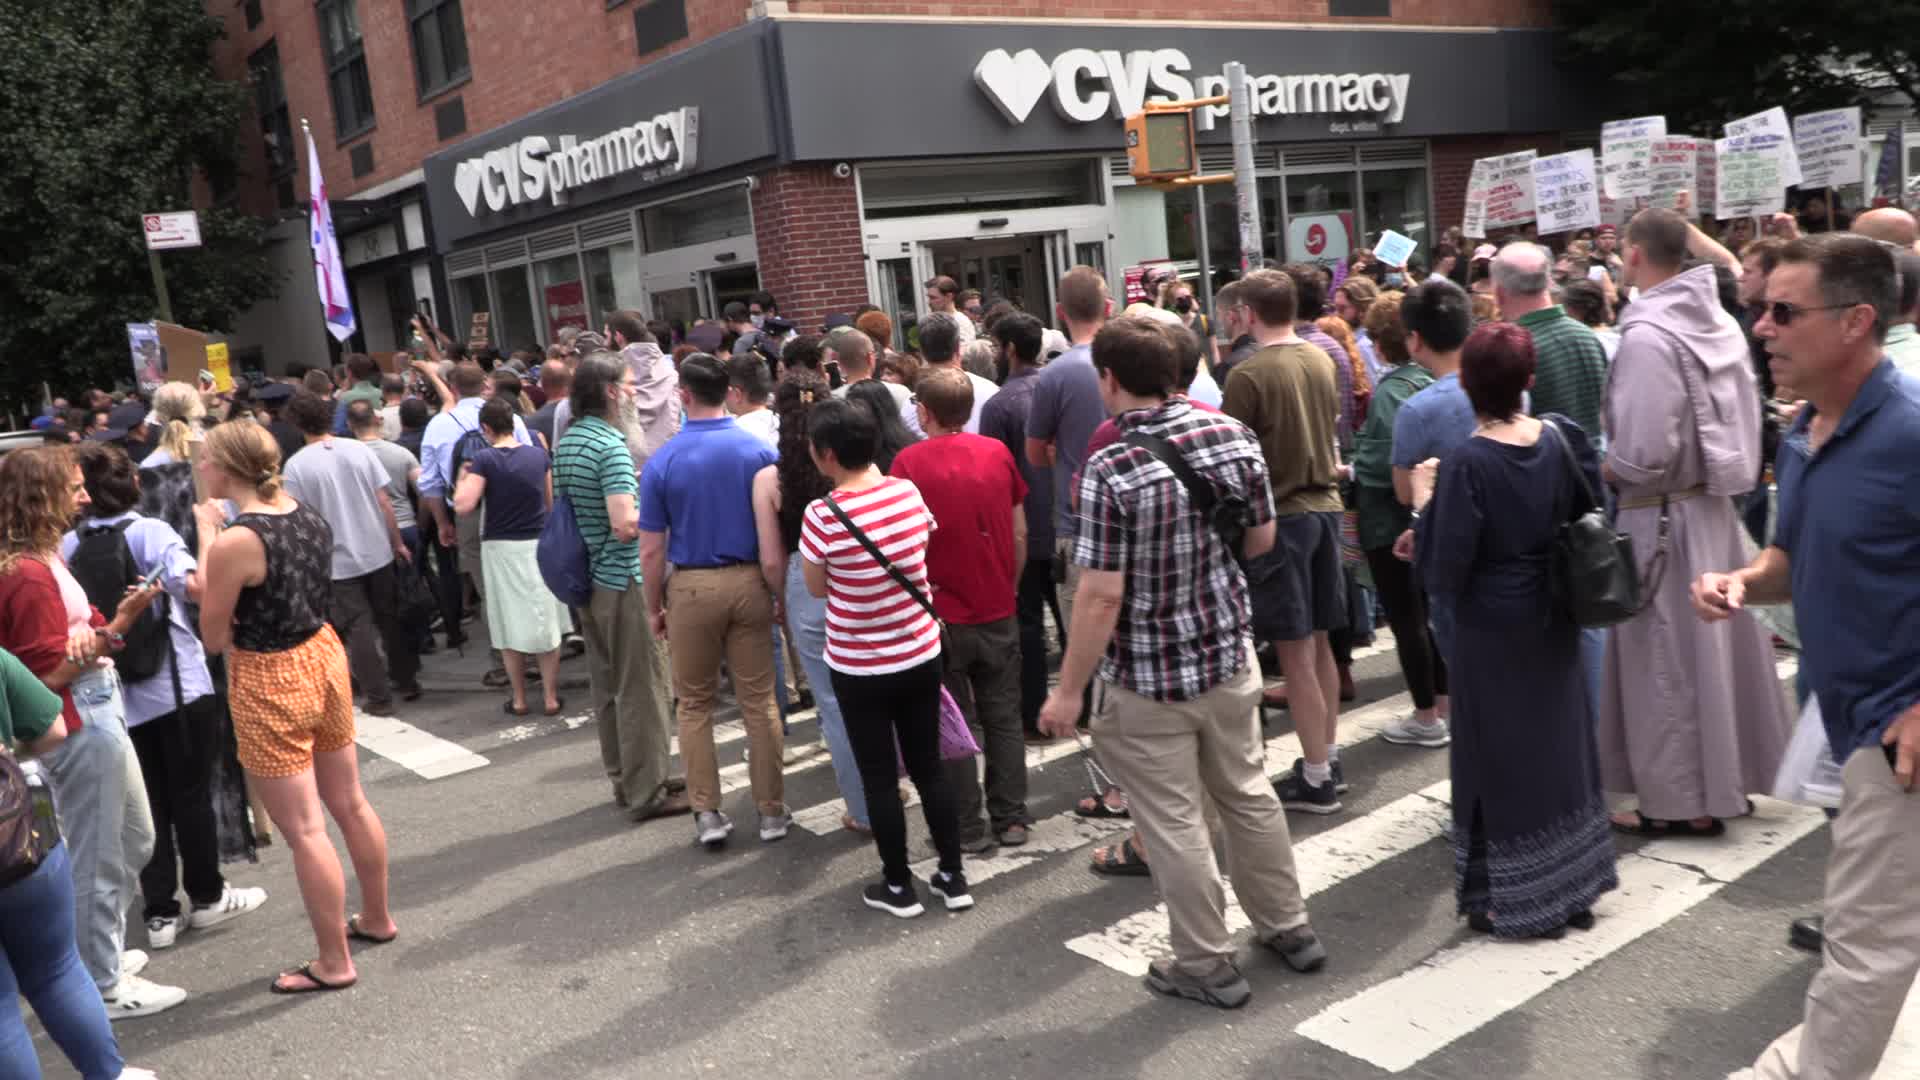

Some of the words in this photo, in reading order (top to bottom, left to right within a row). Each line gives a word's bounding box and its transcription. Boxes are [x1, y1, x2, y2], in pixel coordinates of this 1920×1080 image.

[1052, 48, 1196, 123] CVS
[1196, 73, 1410, 131] pharmacy
[482, 136, 551, 212] CVS
[546, 107, 699, 206] pharmacy
